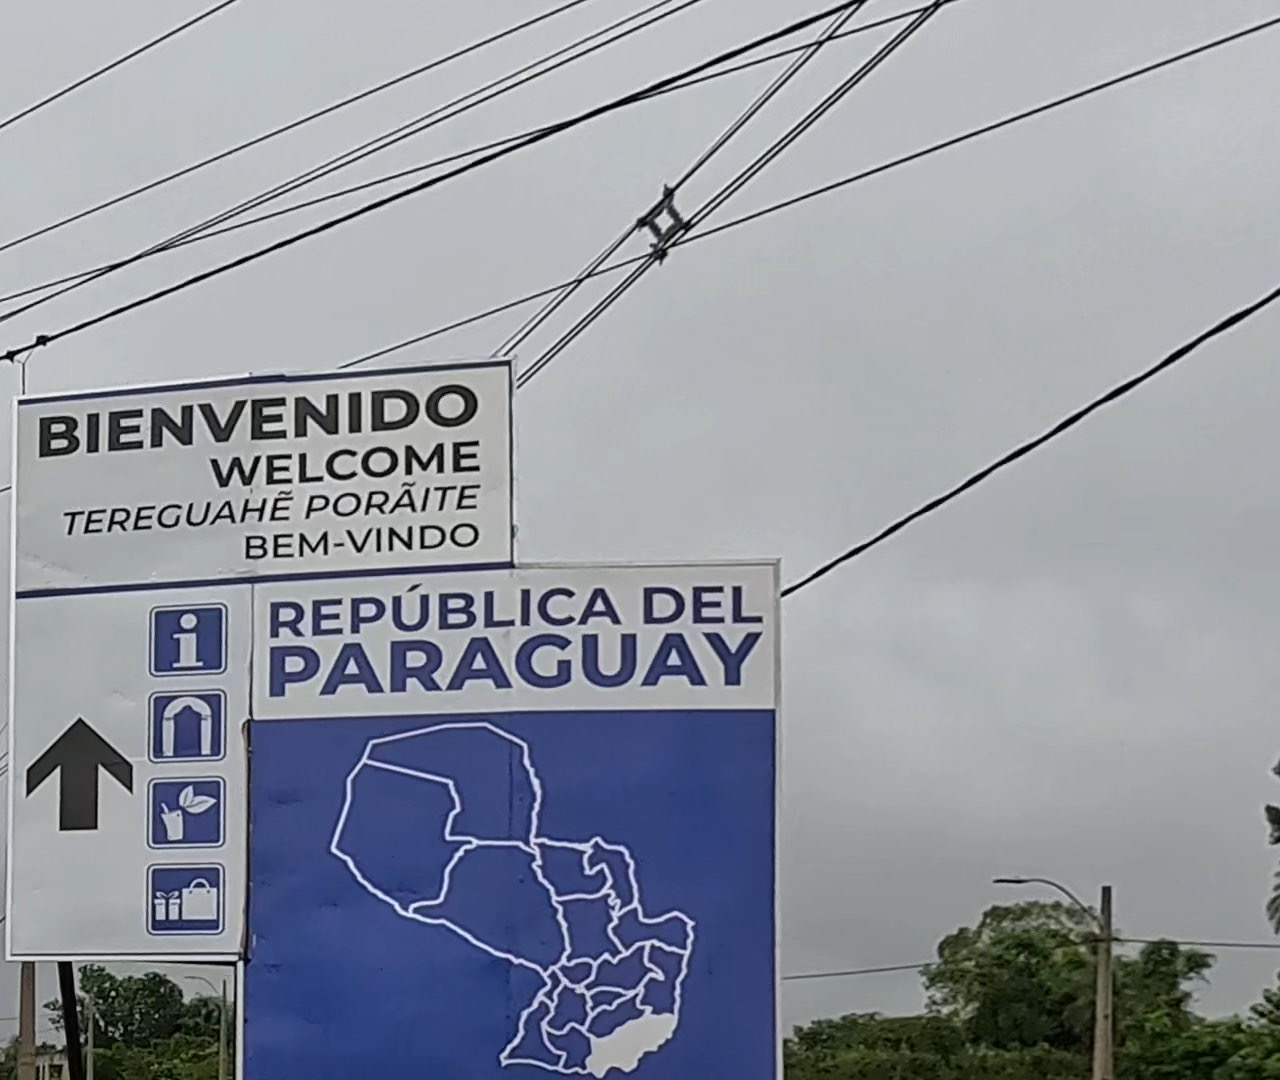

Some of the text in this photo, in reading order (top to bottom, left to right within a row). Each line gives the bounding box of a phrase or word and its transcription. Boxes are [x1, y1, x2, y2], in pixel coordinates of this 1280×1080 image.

[39, 384, 478, 457] BIENVENIDO
[211, 441, 481, 488] WELCOME
[64, 483, 481, 535] TEREGUAHẼ PORÃITE
[245, 522, 480, 559] BEM-VINDO
[270, 584, 763, 637] REPÚBLICA DEL
[269, 632, 763, 697] PARAGUAY
